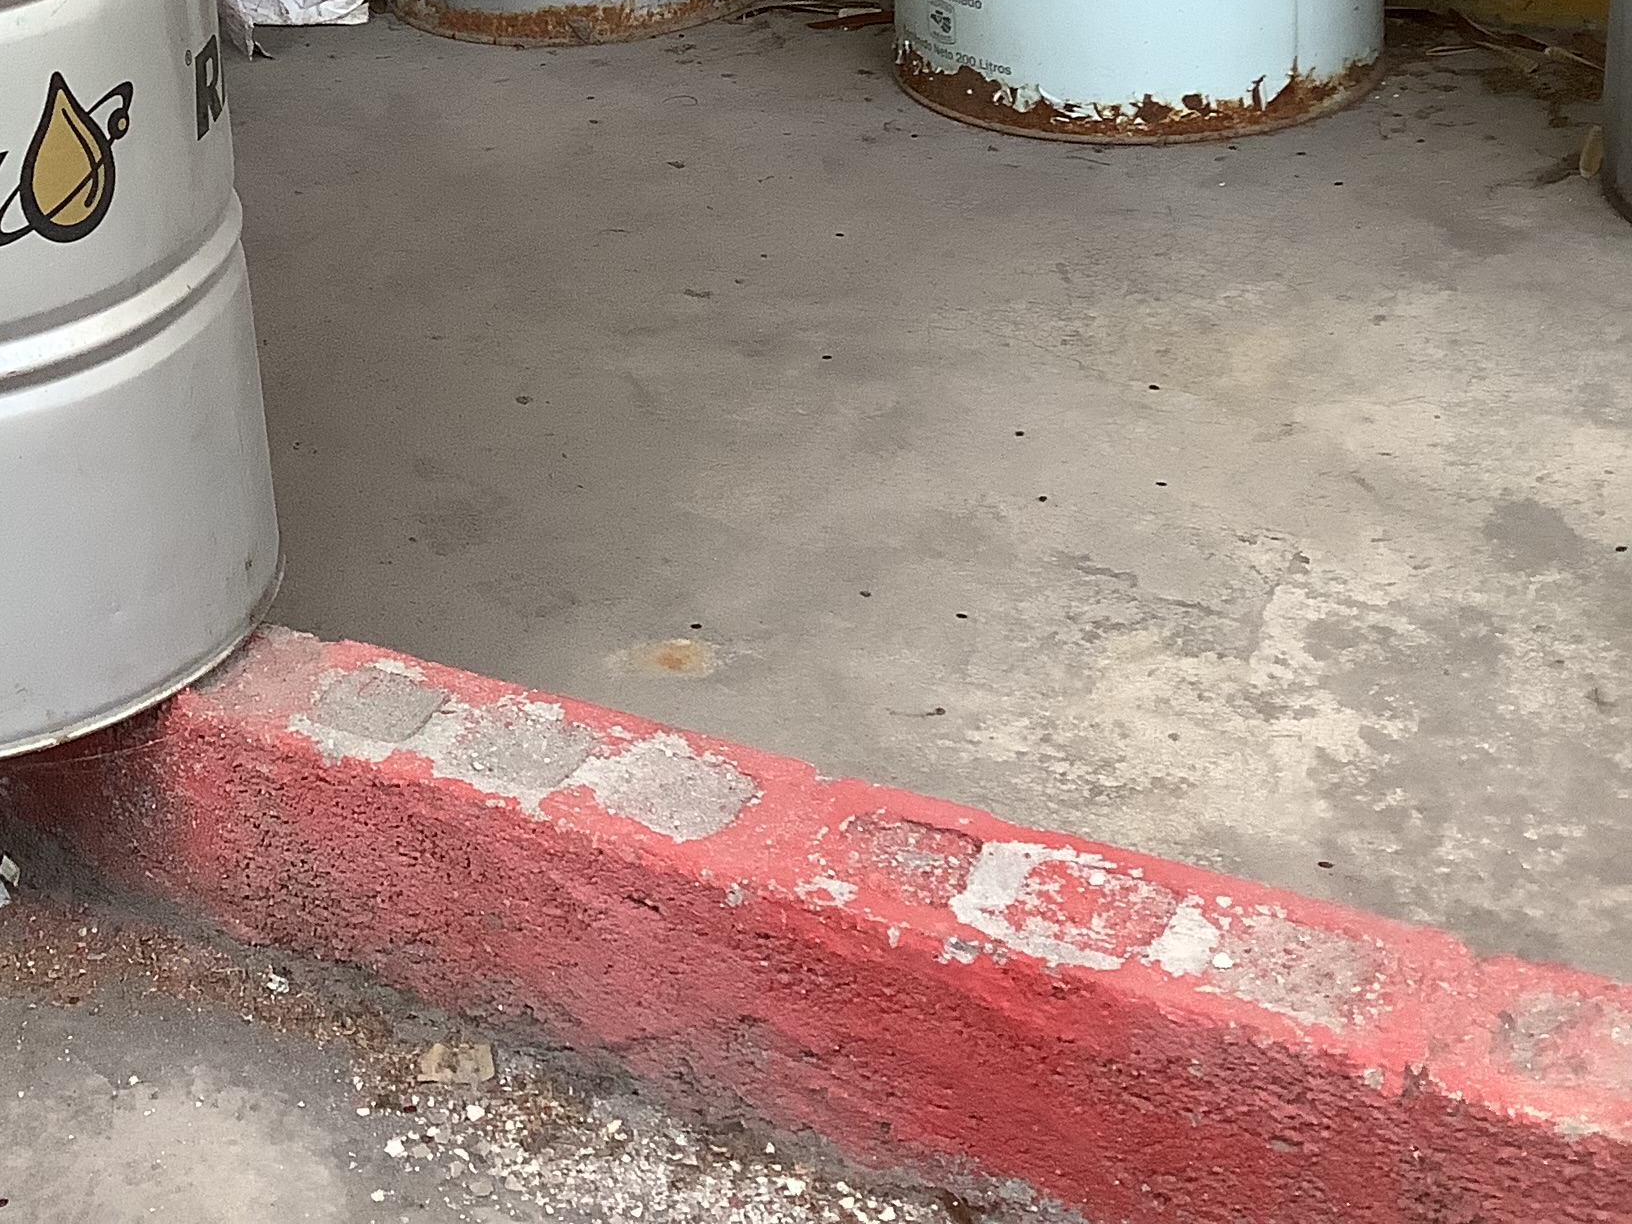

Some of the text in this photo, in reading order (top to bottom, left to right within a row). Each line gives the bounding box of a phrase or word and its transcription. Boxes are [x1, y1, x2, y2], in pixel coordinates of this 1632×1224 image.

[195, 35, 225, 141] R
[955, 52, 976, 67] 200
[979, 59, 1012, 76] Litros
